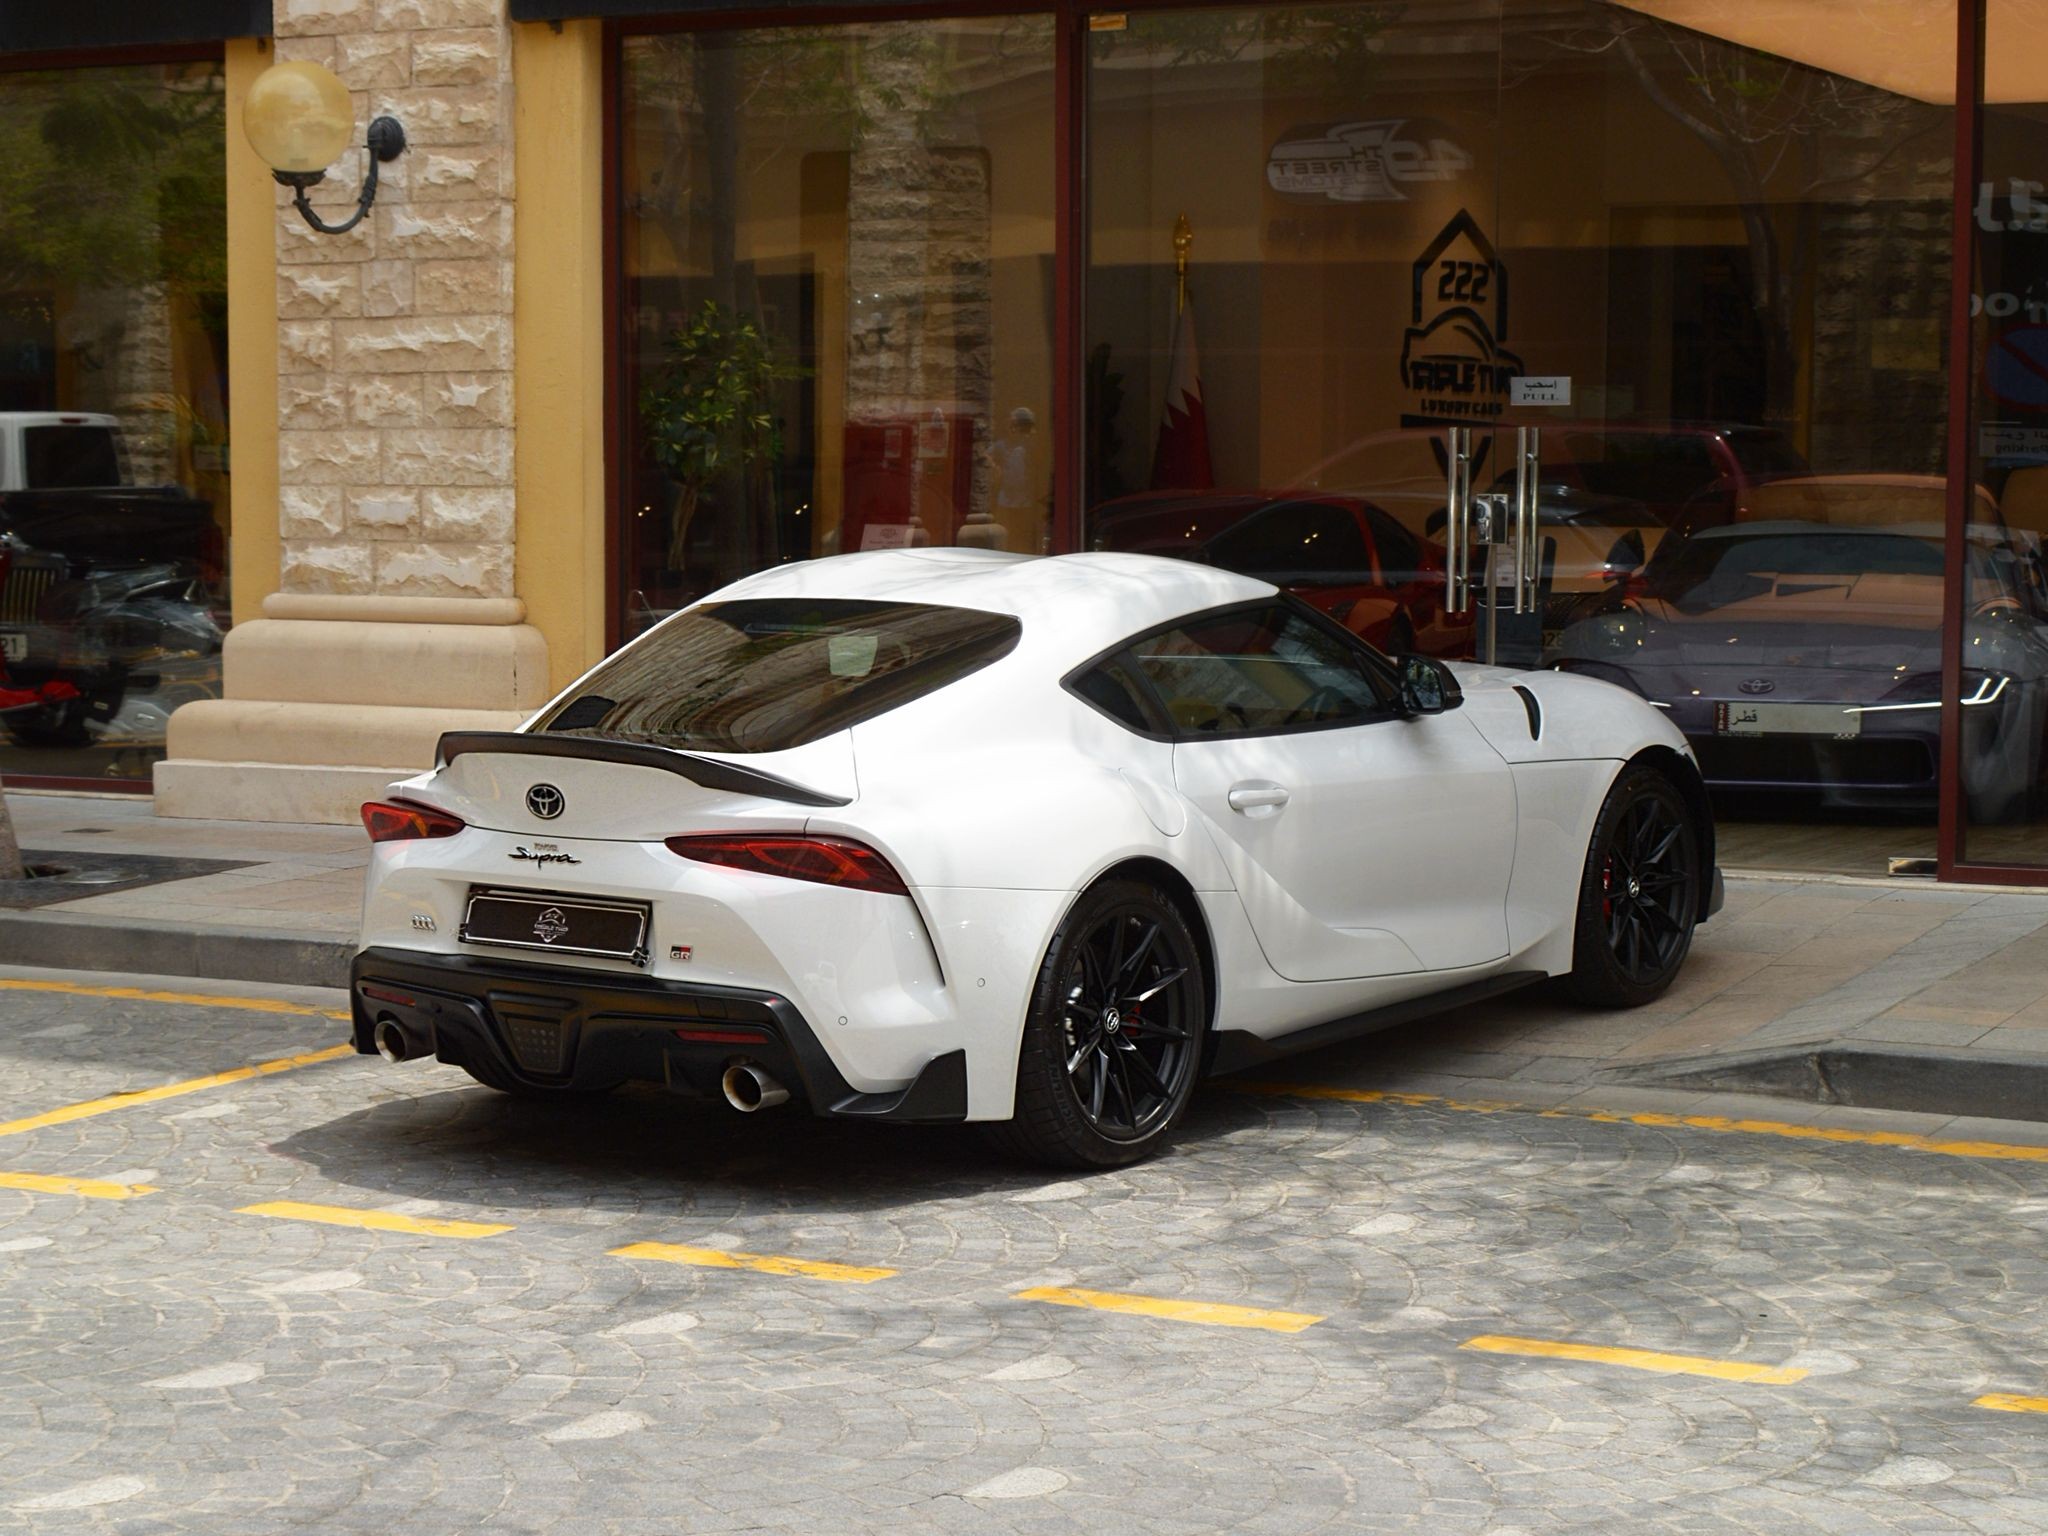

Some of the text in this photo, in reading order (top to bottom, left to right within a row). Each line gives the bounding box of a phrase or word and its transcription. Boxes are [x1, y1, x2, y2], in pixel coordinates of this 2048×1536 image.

[1438, 261, 1491, 303] 222
[1408, 360, 1475, 394] TRIPLE
[1523, 393, 1560, 401] PULL
[1419, 398, 1471, 415] LUXURY
[1731, 709, 1758, 726] قطر
[508, 846, 582, 870] Supra
[671, 950, 691, 960] GR
